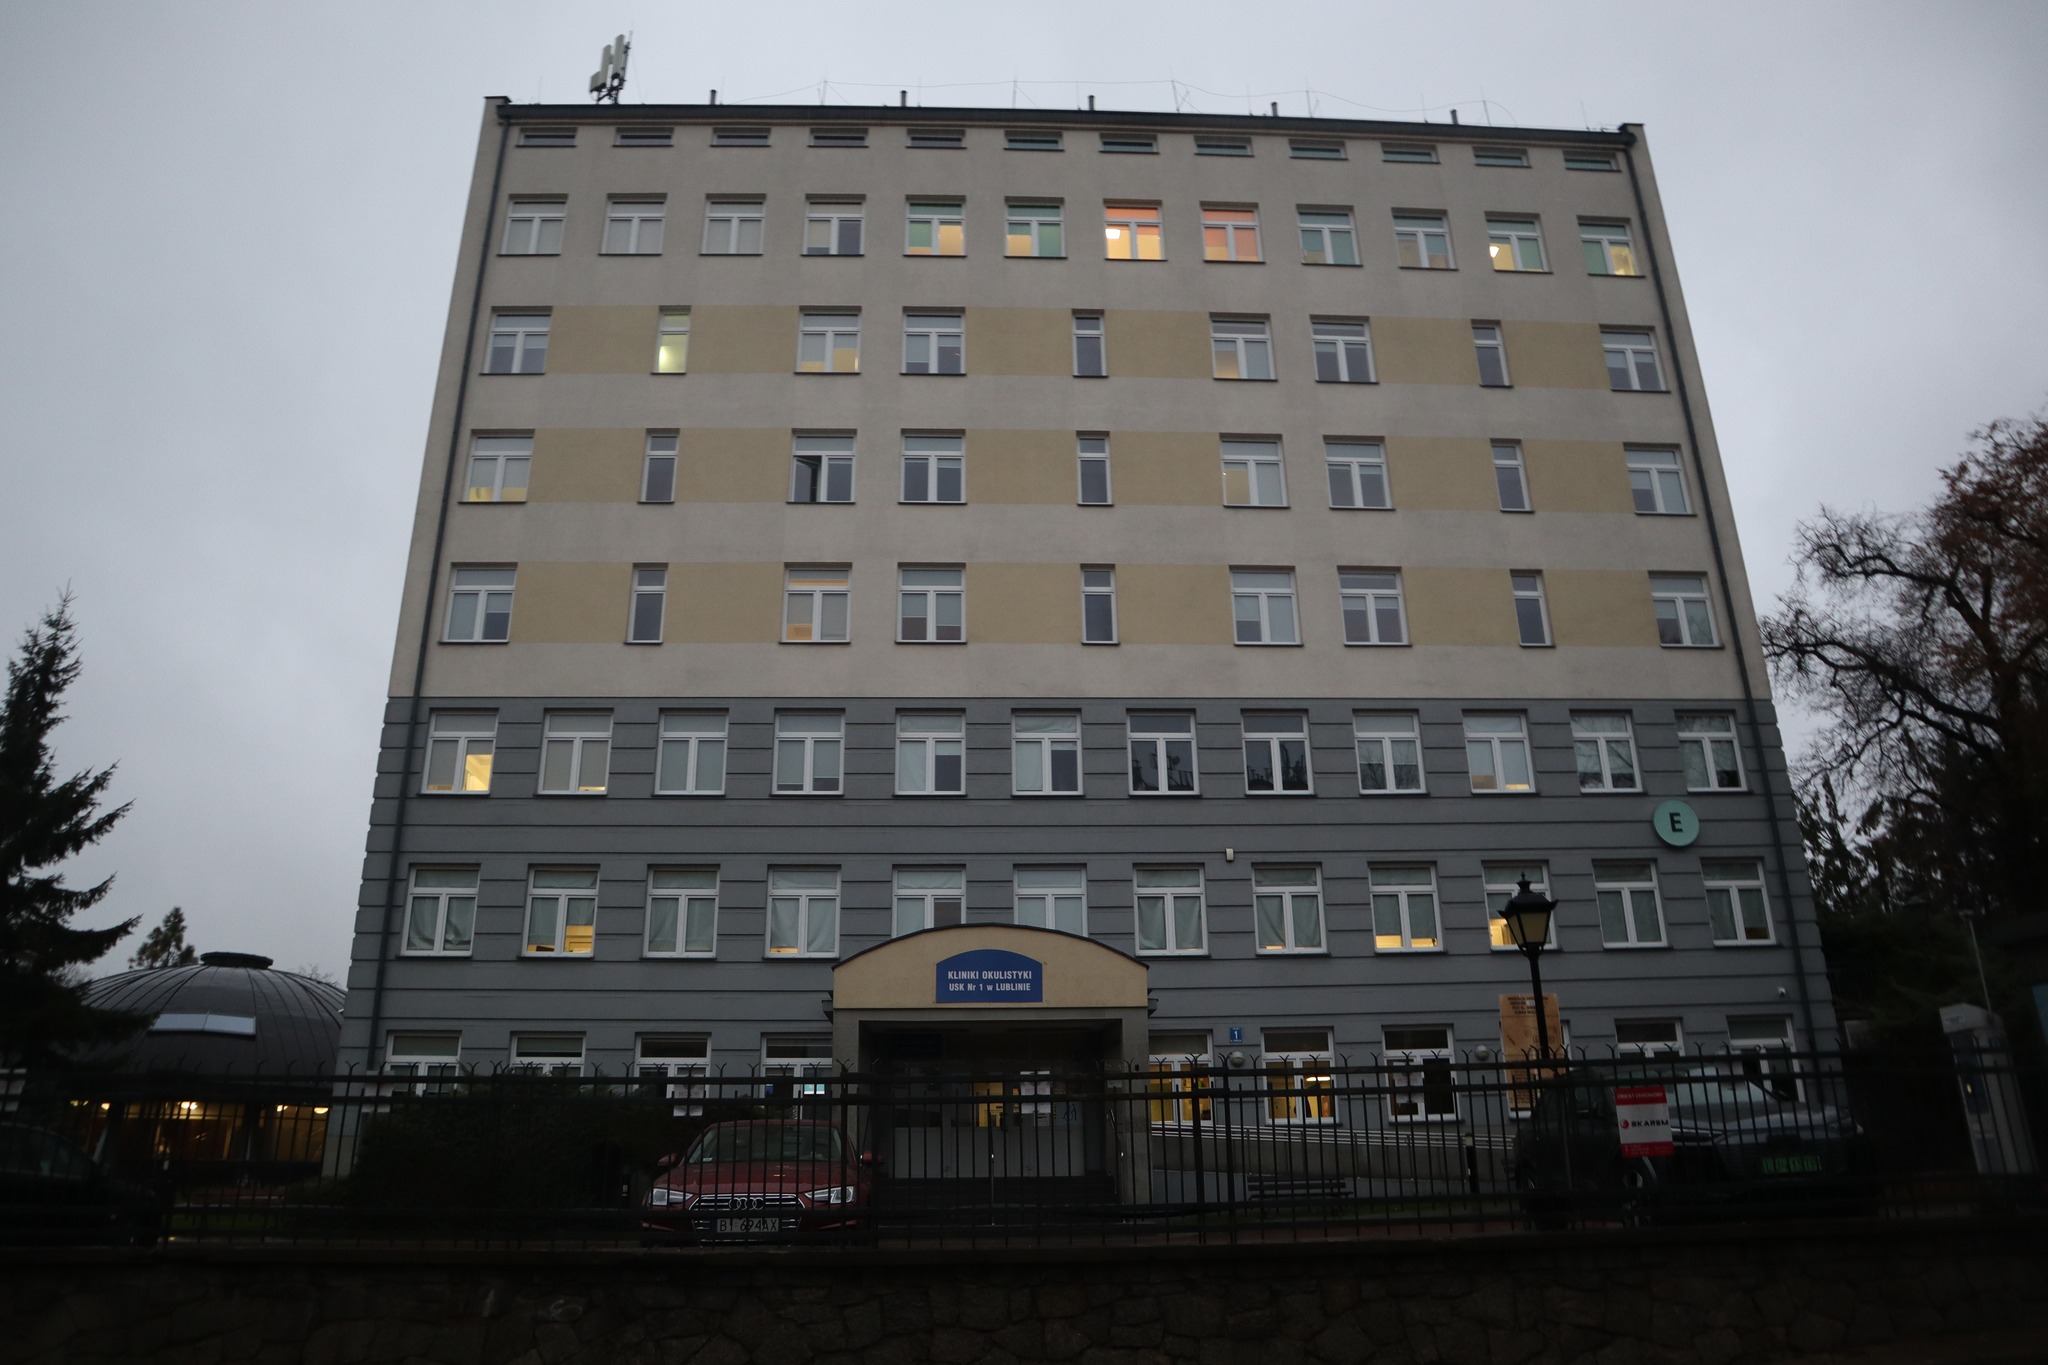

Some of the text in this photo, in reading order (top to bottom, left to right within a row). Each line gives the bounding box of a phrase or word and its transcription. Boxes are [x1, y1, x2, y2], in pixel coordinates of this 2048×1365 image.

[1669, 812, 1683, 832] E
[947, 970, 1032, 980] KLINIKI OKULISTYKI
[949, 983, 965, 991] USK
[967, 983, 976, 991] Nr
[996, 982, 1031, 991] LUBLINIE
